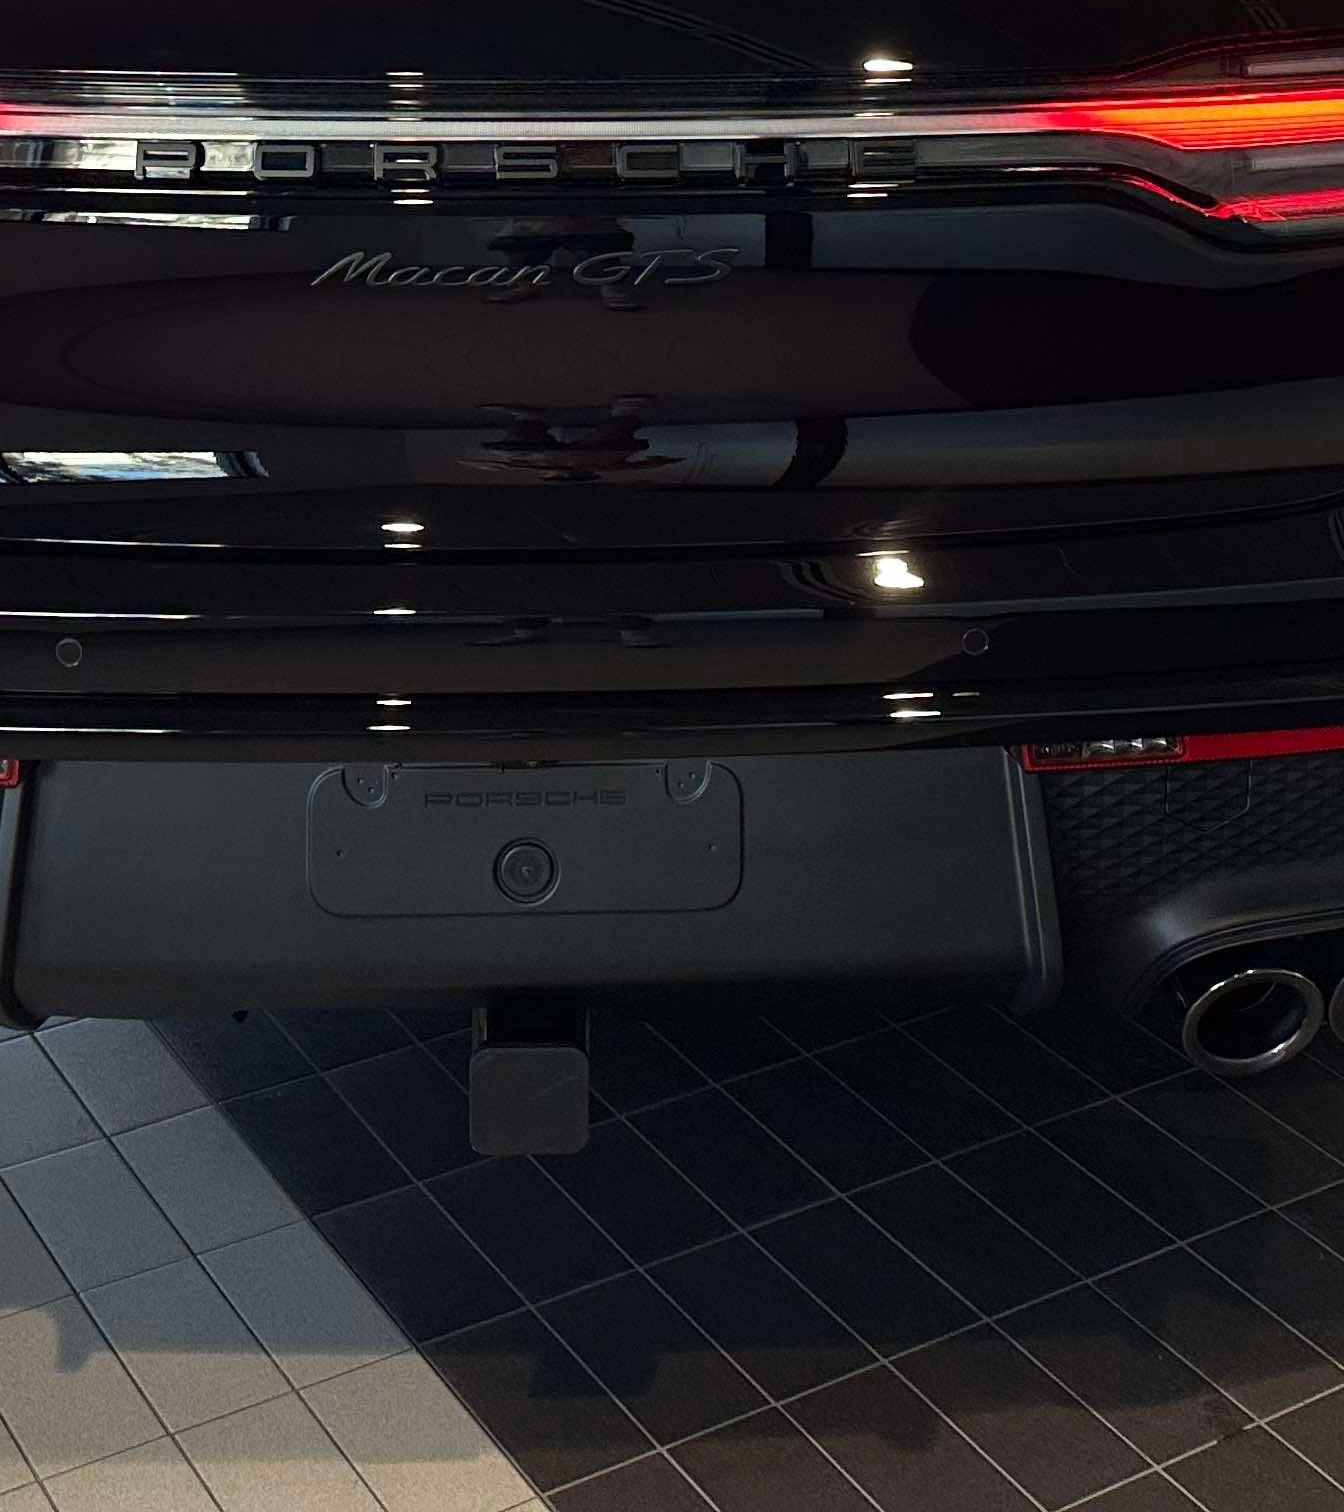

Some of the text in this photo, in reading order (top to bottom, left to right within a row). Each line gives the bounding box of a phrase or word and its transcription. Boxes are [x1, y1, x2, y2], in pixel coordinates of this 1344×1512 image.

[137, 140, 915, 186] PORSCHE
[310, 248, 740, 287] Macan GTS
[424, 791, 627, 808] PORSCHE
